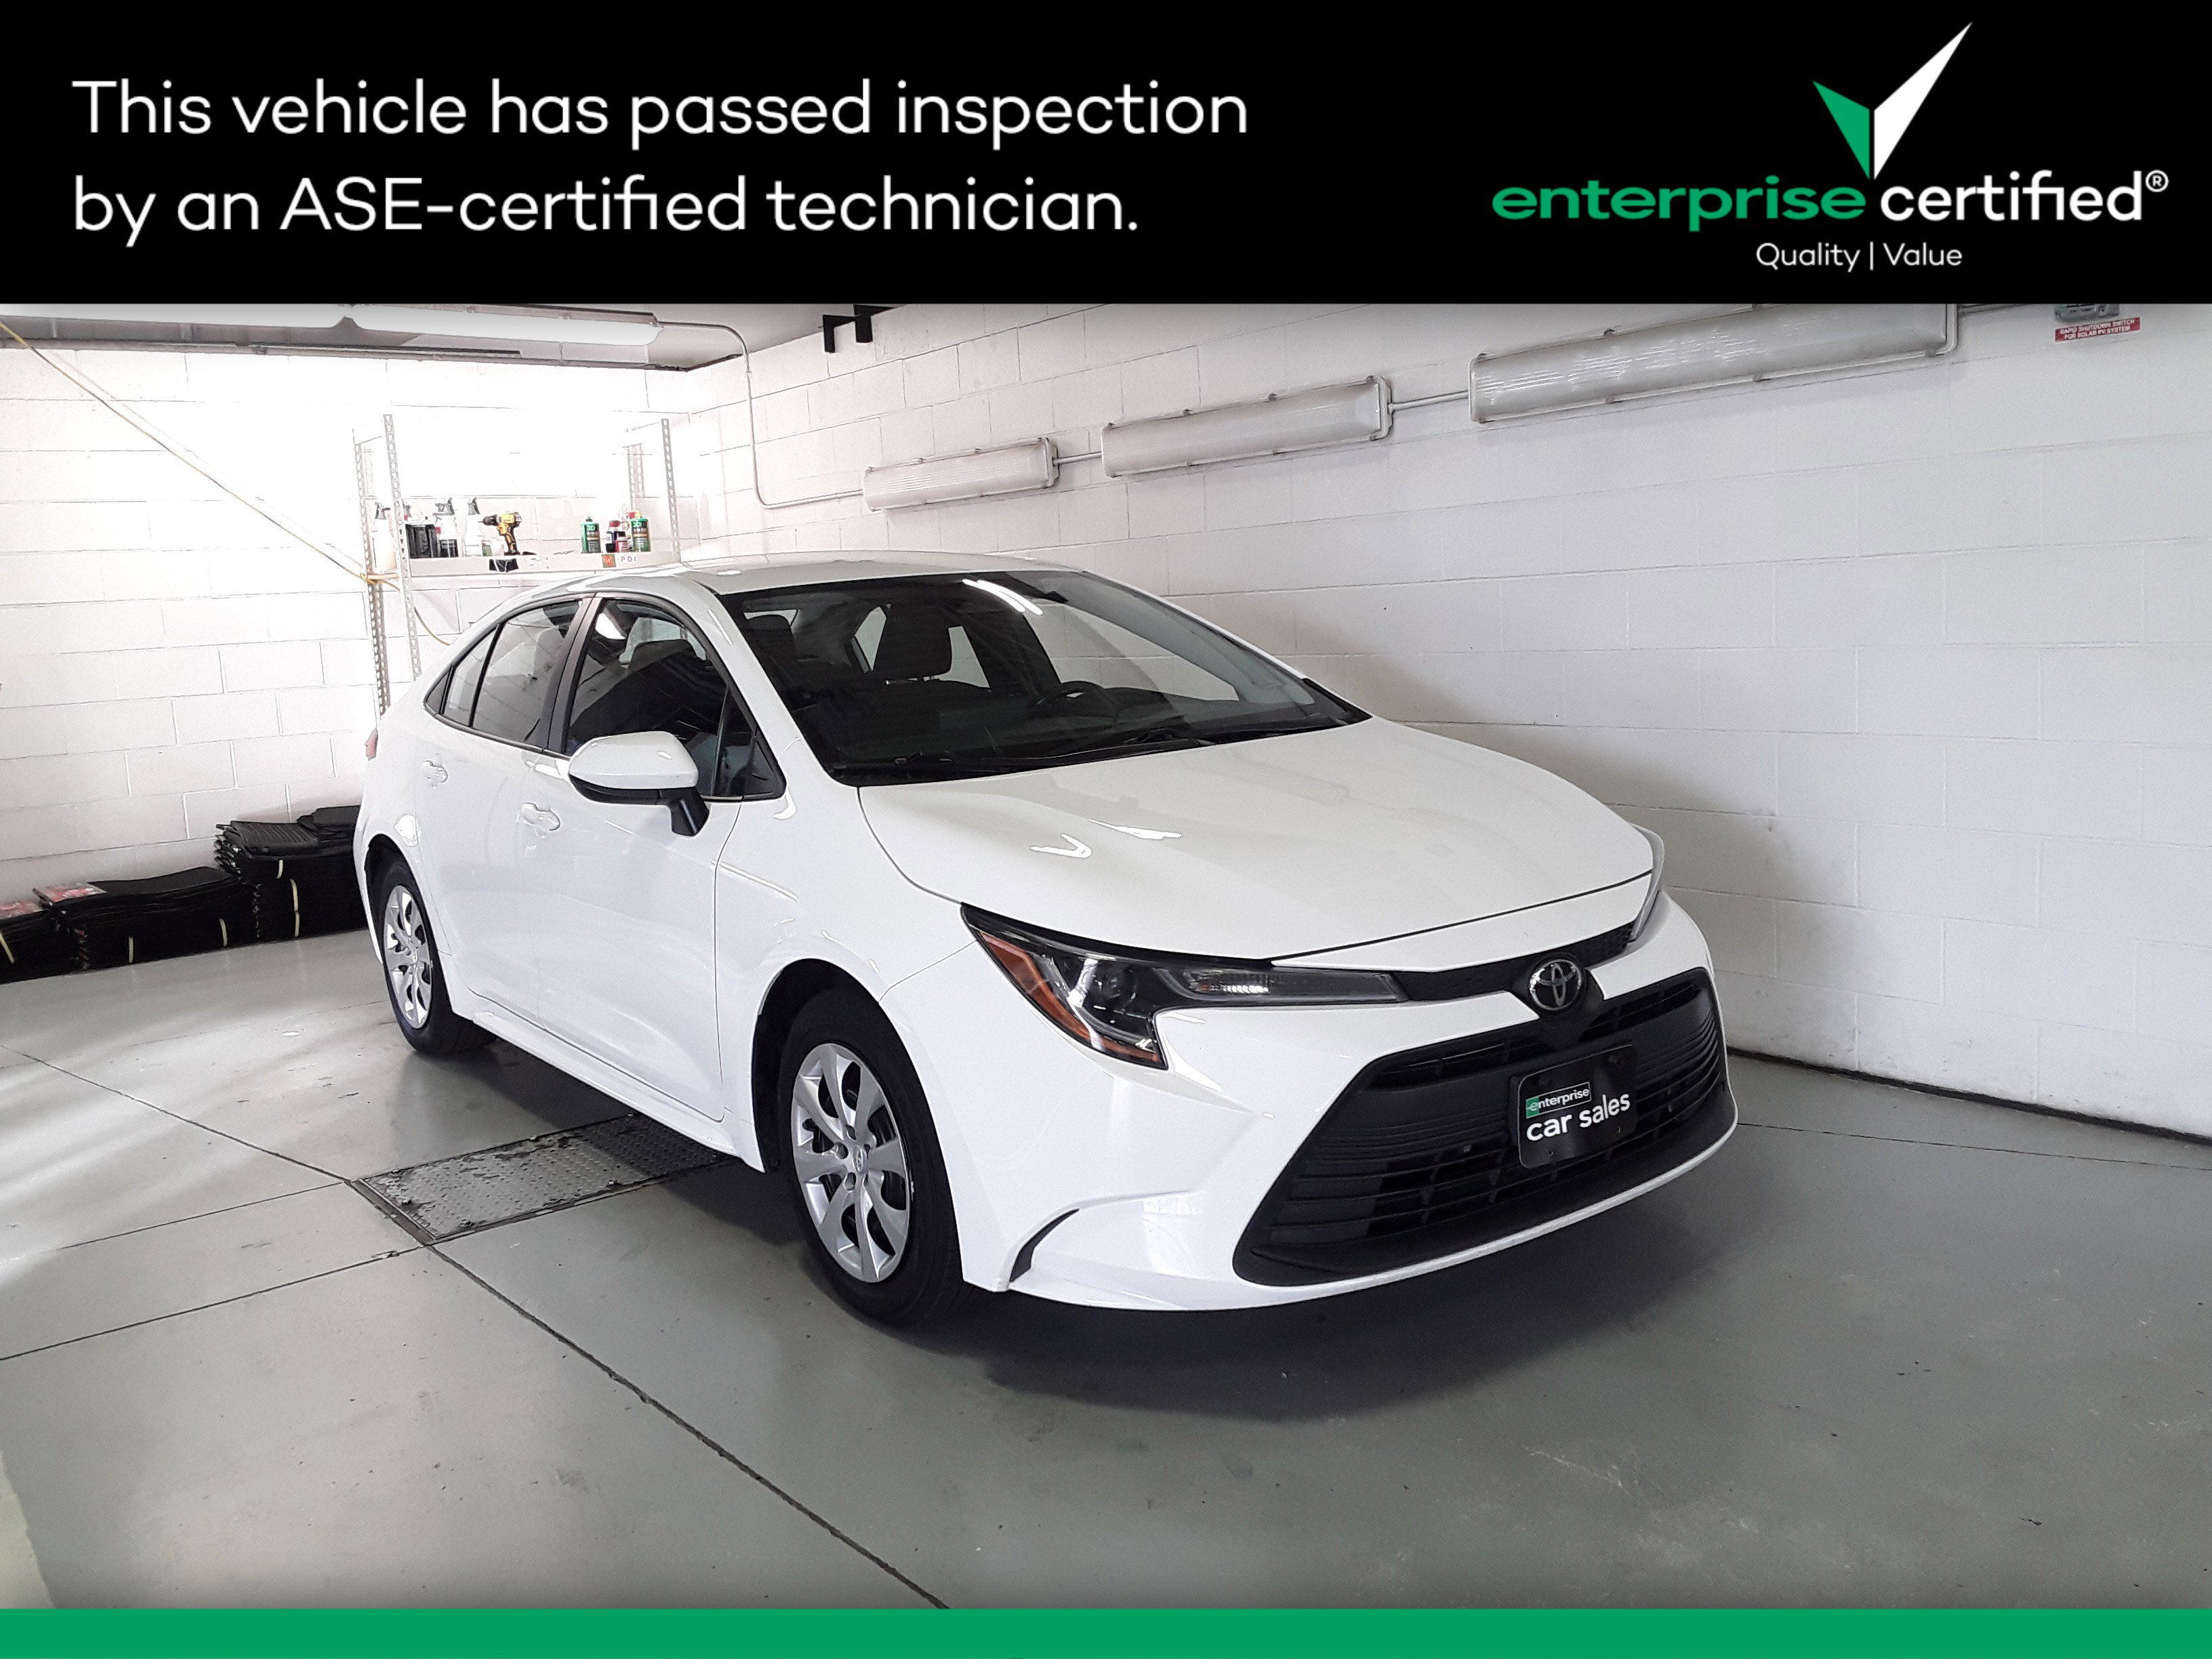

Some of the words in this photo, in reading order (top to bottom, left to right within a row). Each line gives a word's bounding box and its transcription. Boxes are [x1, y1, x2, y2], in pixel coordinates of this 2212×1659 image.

[1529, 1088, 1589, 1111] enterprise
[1527, 1114, 1572, 1141] car
[1579, 1094, 1631, 1128] sales
